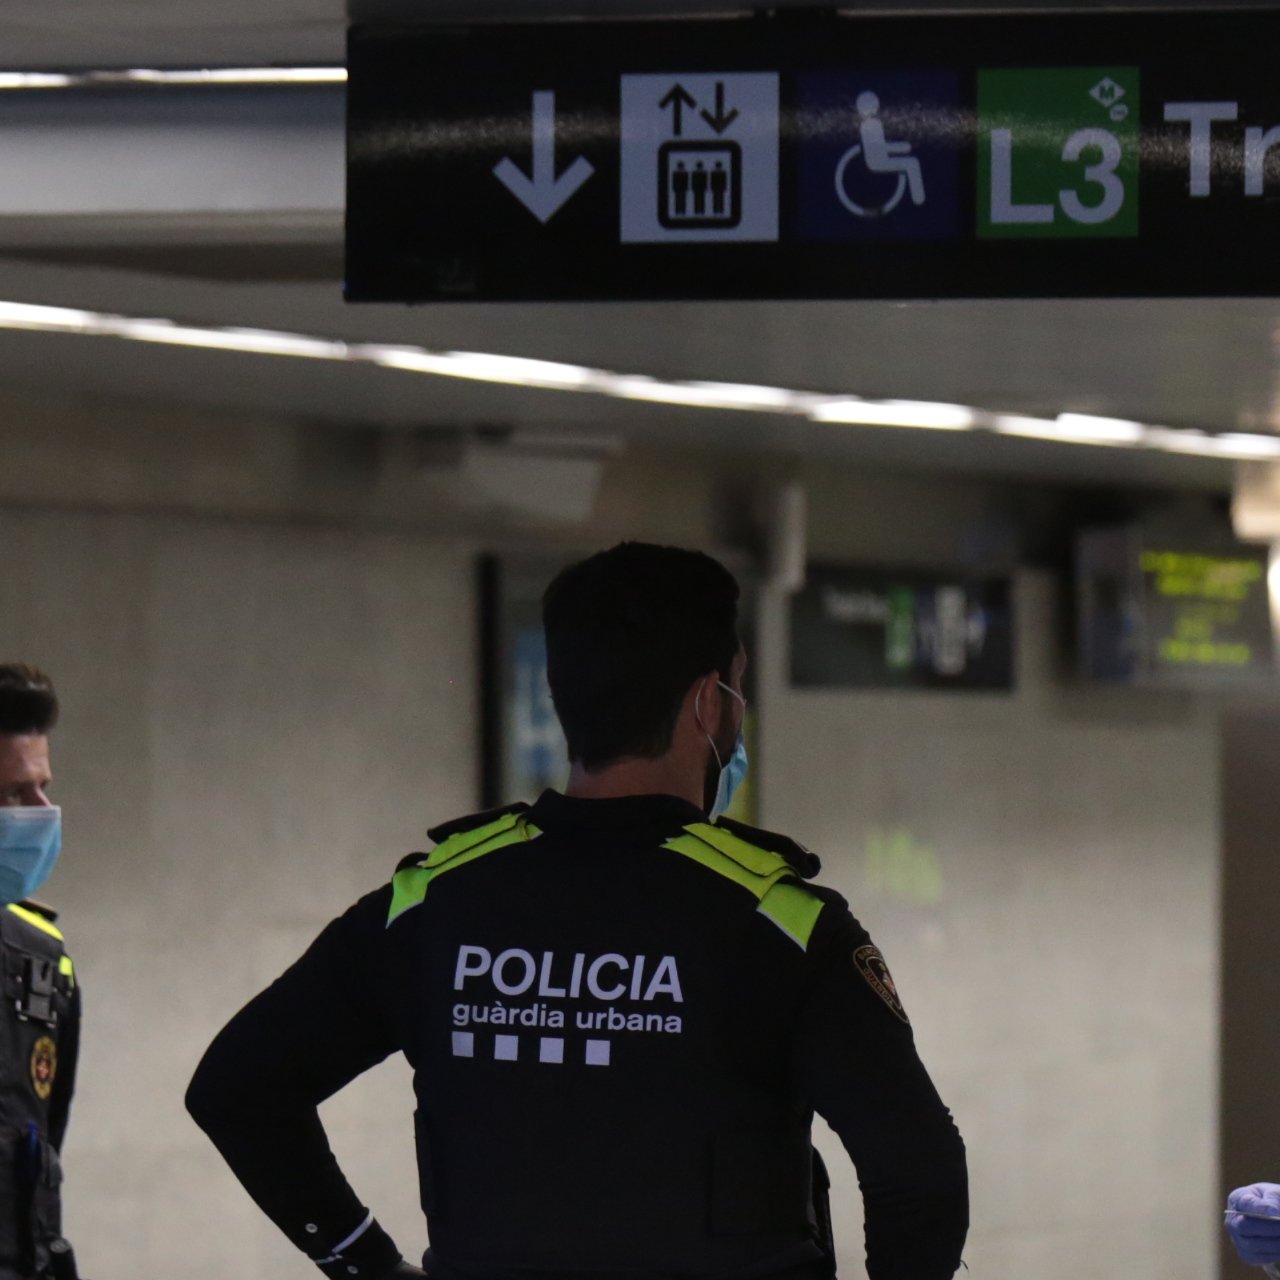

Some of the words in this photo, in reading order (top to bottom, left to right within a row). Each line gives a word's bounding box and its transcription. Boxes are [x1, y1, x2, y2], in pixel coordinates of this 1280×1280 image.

[990, 127, 1125, 225] L3
[453, 944, 684, 1003] POLICIA
[452, 1001, 565, 1028] guàrdia
[576, 1007, 683, 1034] urbana
